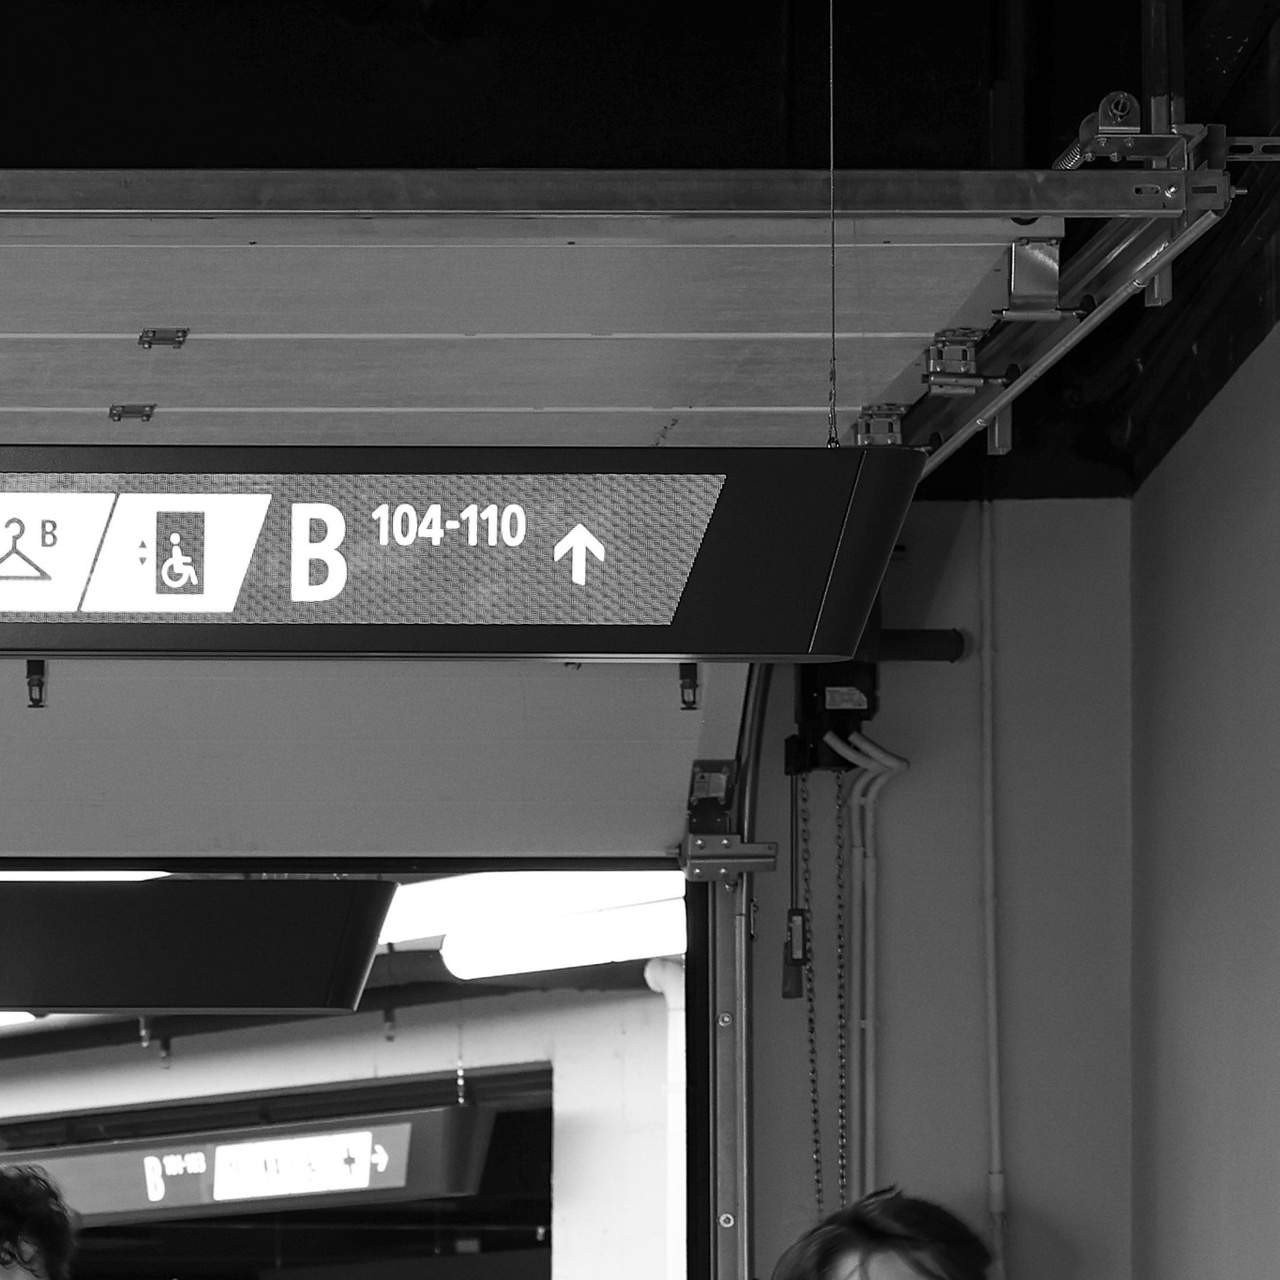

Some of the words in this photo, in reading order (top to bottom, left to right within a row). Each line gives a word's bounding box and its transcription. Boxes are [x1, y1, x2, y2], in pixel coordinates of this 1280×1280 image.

[40, 519, 58, 548] B
[291, 503, 347, 602] B
[372, 504, 526, 546] 104-110
[144, 1156, 165, 1201] B
